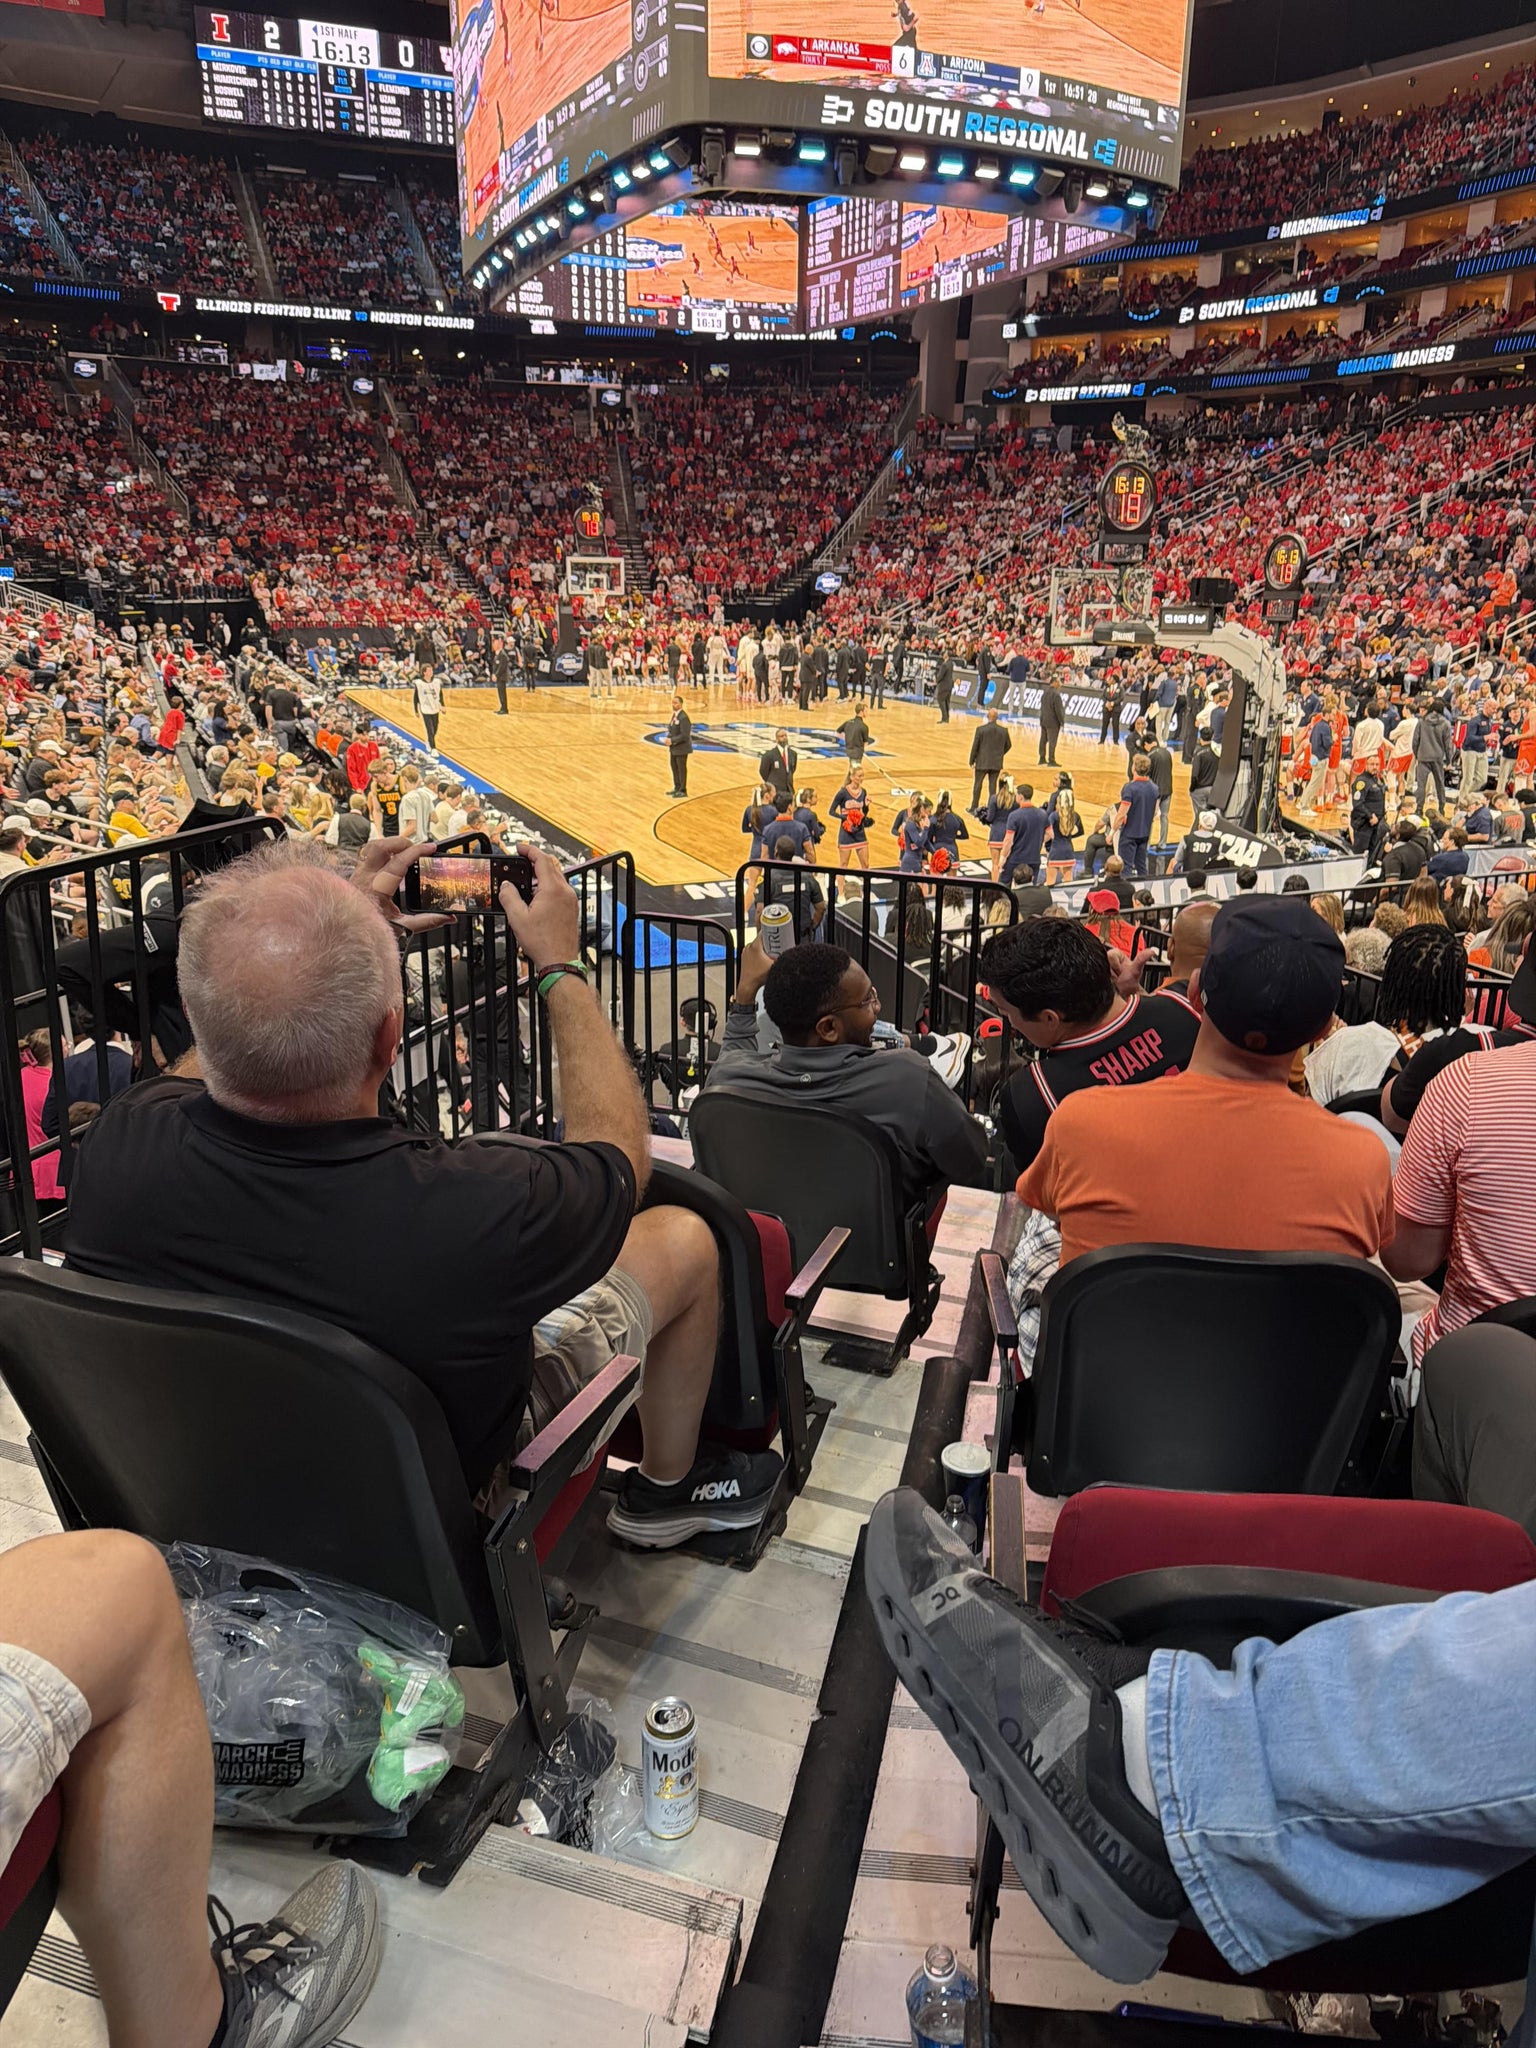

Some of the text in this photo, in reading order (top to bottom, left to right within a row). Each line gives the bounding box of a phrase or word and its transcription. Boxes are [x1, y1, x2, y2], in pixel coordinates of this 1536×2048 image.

[264, 21, 280, 50] 2
[320, 25, 358, 40] 1ST HALF
[211, 50, 231, 59] PLAYER
[312, 39, 370, 65] 16:13
[399, 40, 414, 67] 0
[802, 38, 860, 55] 4 ARKANSAS
[875, 63, 891, 73] POSS
[899, 52, 907, 69] 6
[942, 56, 985, 73] 1 ARIZONA
[261, 68, 267, 77] 0
[285, 71, 291, 80] 0
[297, 73, 303, 82] 0
[310, 74, 315, 83] 0
[1026, 73, 1033, 89] 9
[214, 85, 245, 97] BOSWELL
[263, 91, 269, 100] 0
[287, 94, 293, 103] 0
[299, 95, 305, 105] 0
[311, 97, 317, 106] 0
[262, 79, 268, 89] 0
[274, 81, 280, 90] 0
[286, 82, 292, 91] 0
[298, 84, 304, 93] 0
[310, 85, 316, 94] 0
[1064, 82, 1084, 101] 16:51
[1087, 89, 1097, 104] 28
[216, 108, 243, 120] WAGLER
[265, 114, 270, 123] 0
[289, 117, 295, 126] 0
[301, 118, 306, 127] 0
[313, 119, 318, 128] 0
[288, 105, 294, 115] 0
[300, 107, 306, 116] 0
[312, 108, 317, 117] 0
[864, 98, 1089, 161] SOUTH REGIONAL
[966, 271, 972, 288] 0
[520, 303, 553, 317] MCCARTY
[1198, 288, 1318, 320] SOUTH REGIONAL
[195, 298, 475, 330] ILLINOIS FIGHTING ILLINI VS HOUSTON COUGARS
[733, 315, 741, 329] 0
[696, 318, 722, 329] 16:13
[1337, 344, 1456, 376] #MARCHMADNESS
[1039, 383, 1131, 402] SWEET SIXTEEN
[1115, 476, 1145, 494] 16:13
[1120, 493, 1141, 524] 18
[1276, 549, 1299, 565] 16:13
[1279, 564, 1293, 583] 18
[1089, 1027, 1164, 1086] SHARP
[690, 1478, 741, 1503] HOKA
